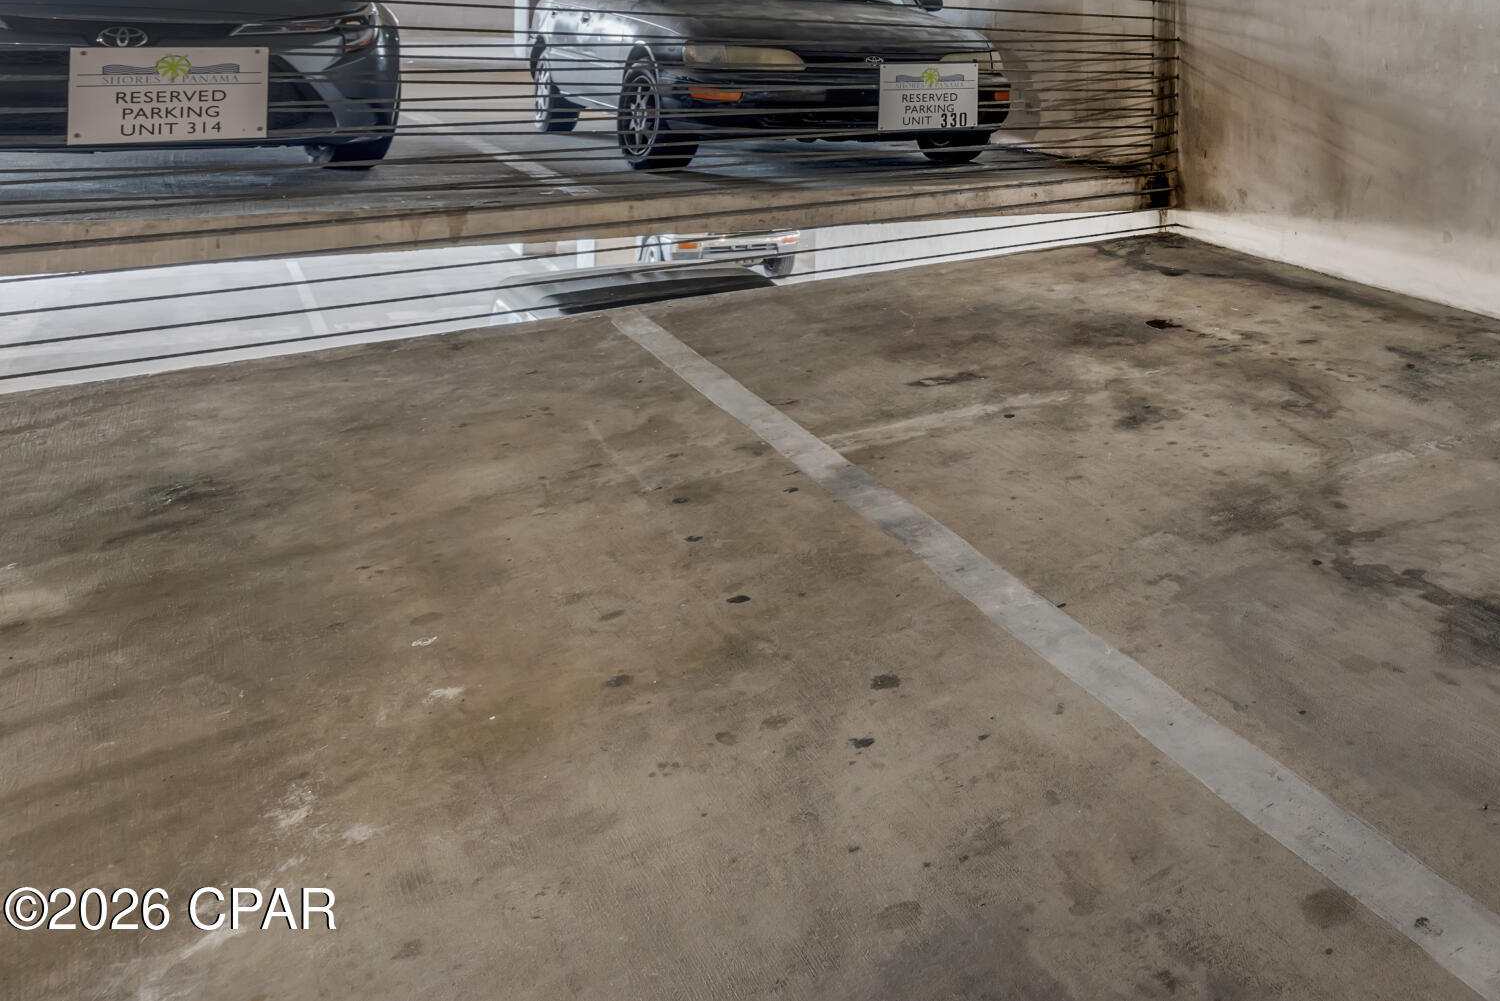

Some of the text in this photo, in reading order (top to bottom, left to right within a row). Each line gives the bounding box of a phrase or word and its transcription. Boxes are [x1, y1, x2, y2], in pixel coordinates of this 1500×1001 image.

[102, 76, 160, 84] SHORES
[182, 74, 239, 83] PANAMA
[115, 89, 227, 104] RESERVED
[902, 93, 958, 102] RESERVED
[122, 105, 221, 120] PARKING
[905, 104, 954, 113] PARKING
[903, 116, 932, 125] UNIT
[120, 121, 222, 136] UNIT 314
